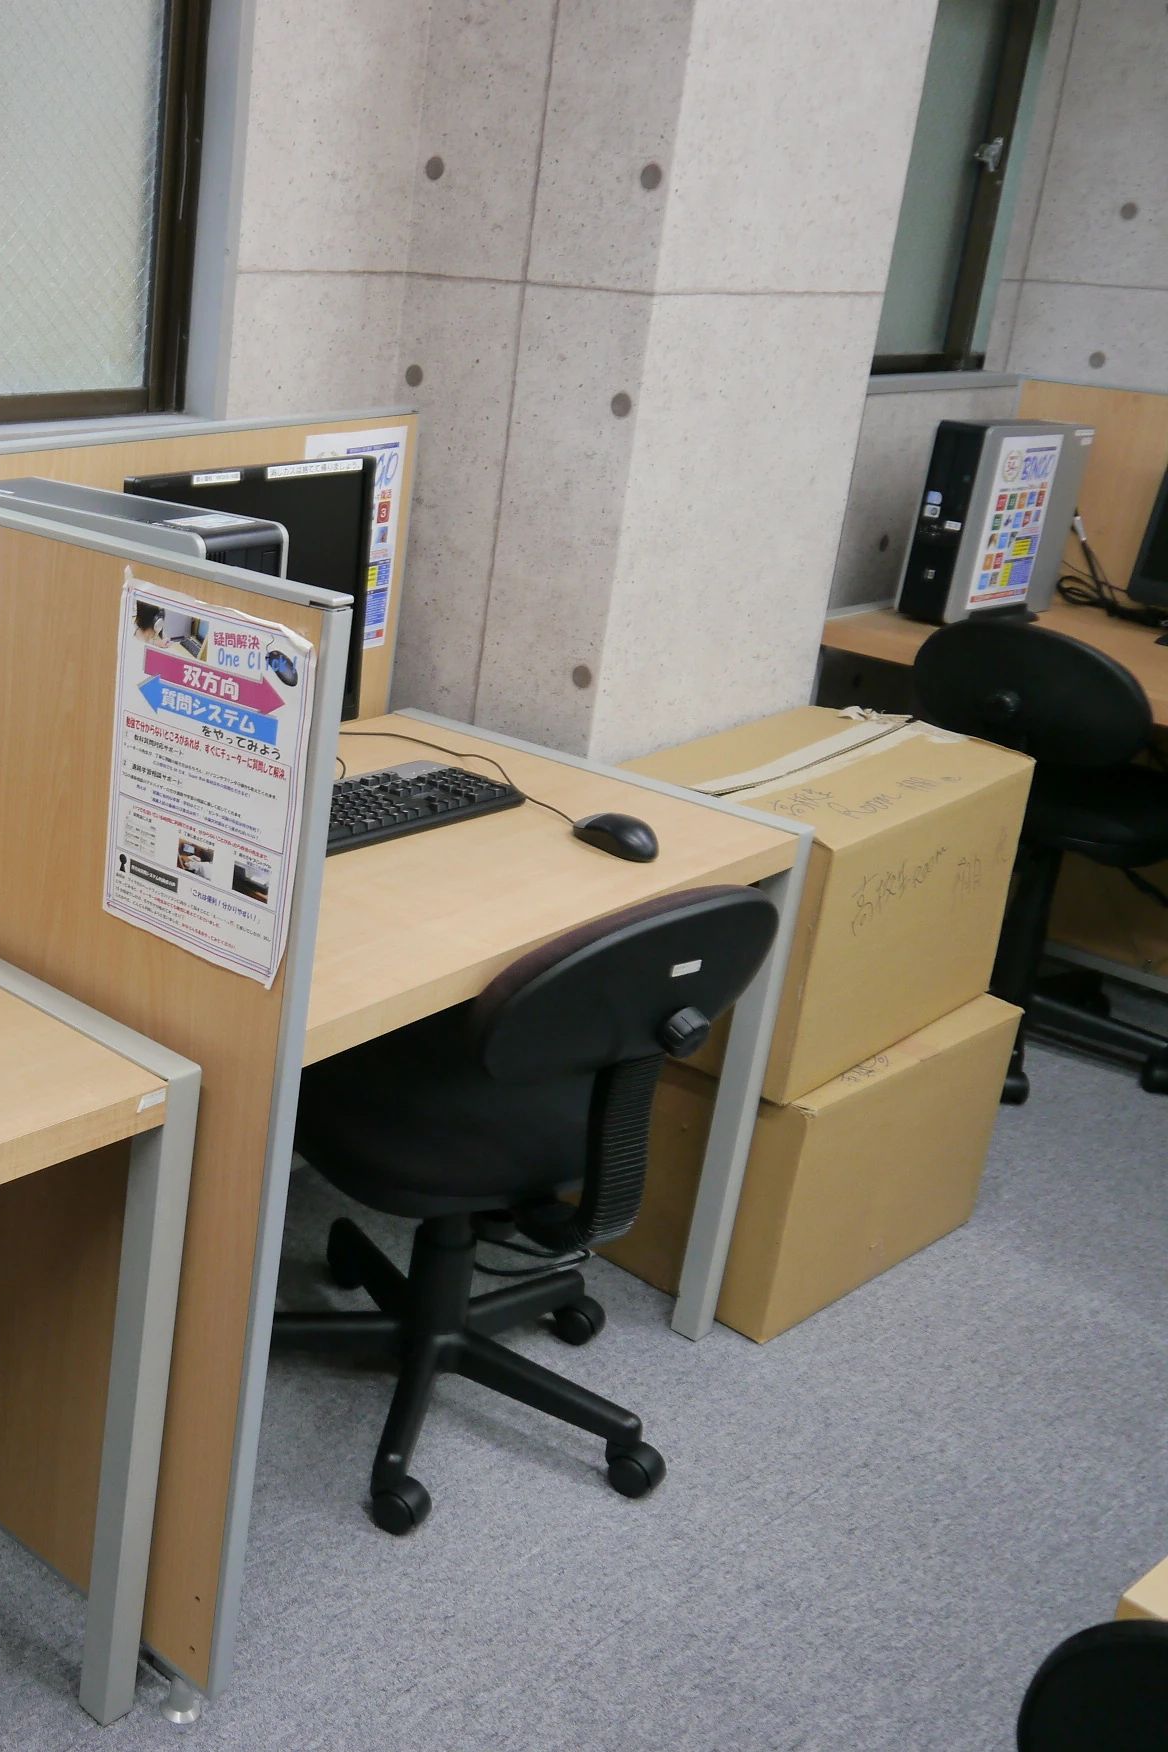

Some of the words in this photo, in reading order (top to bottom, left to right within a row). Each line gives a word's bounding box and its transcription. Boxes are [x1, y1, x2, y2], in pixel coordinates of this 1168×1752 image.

[214, 632, 260, 650] 疑問解決
[218, 647, 240, 667] One
[183, 664, 240, 701] 双方向
[162, 688, 255, 734] 質問システム
[202, 725, 280, 760] をやってみよう
